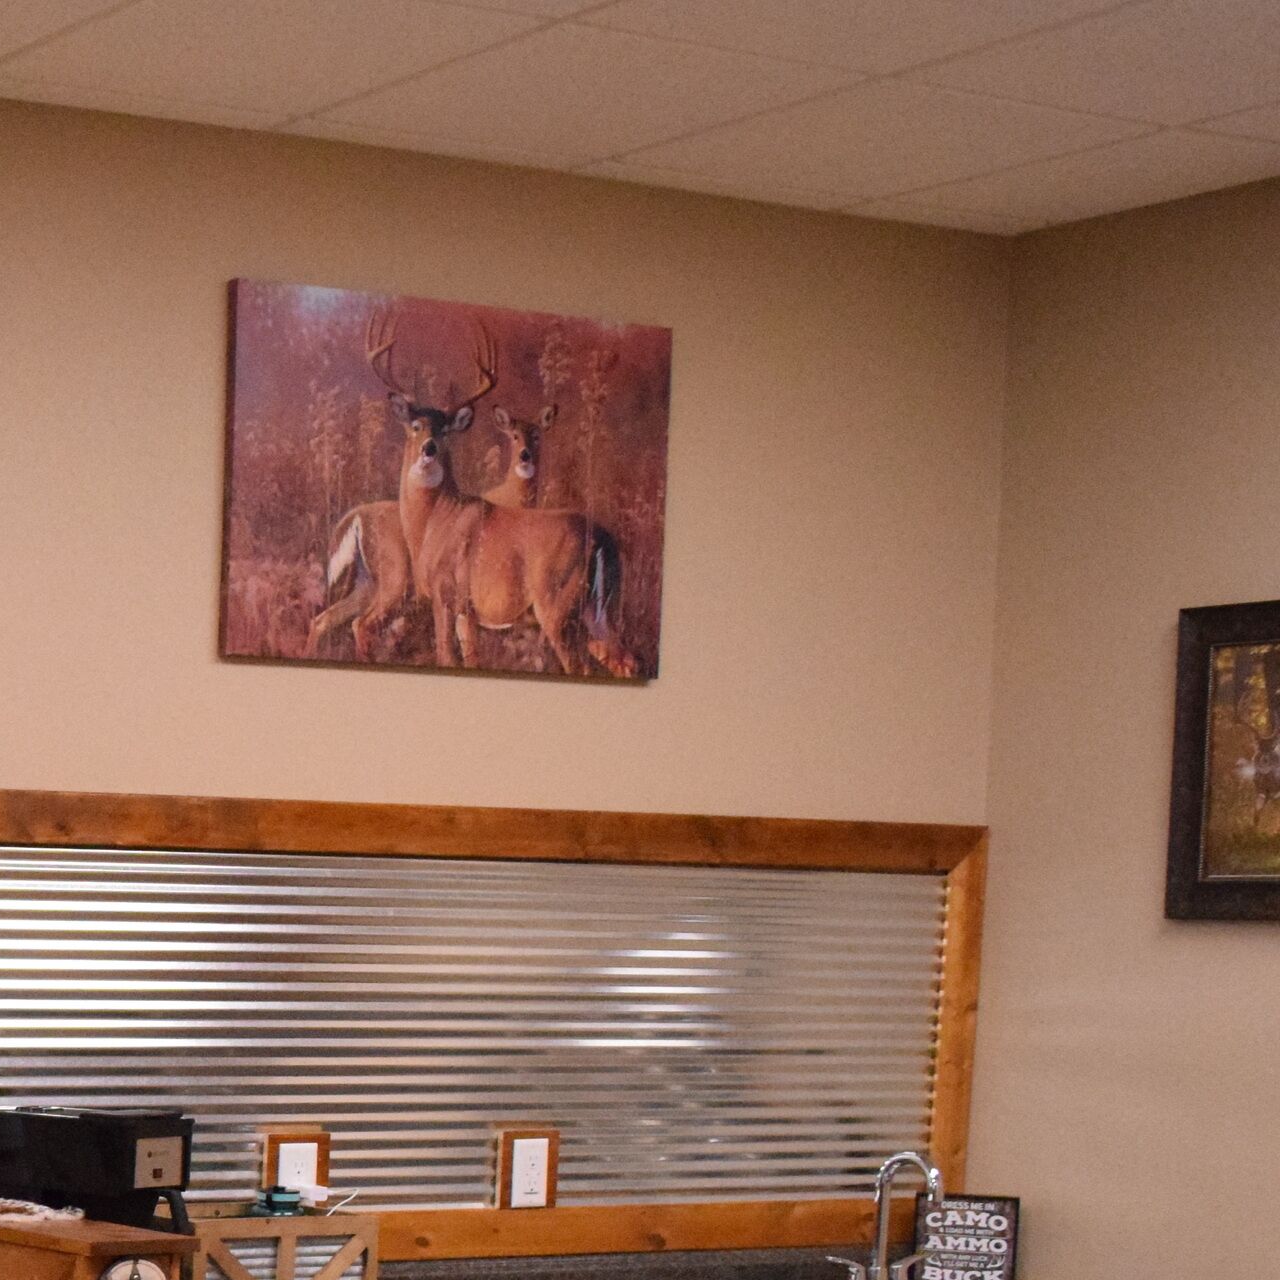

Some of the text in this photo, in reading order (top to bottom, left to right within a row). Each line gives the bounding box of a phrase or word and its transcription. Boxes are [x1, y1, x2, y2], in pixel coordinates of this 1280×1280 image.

[970, 1202, 983, 1210] ME
[925, 1210, 1008, 1232] CAMO
[924, 1235, 1008, 1253] AMMO
